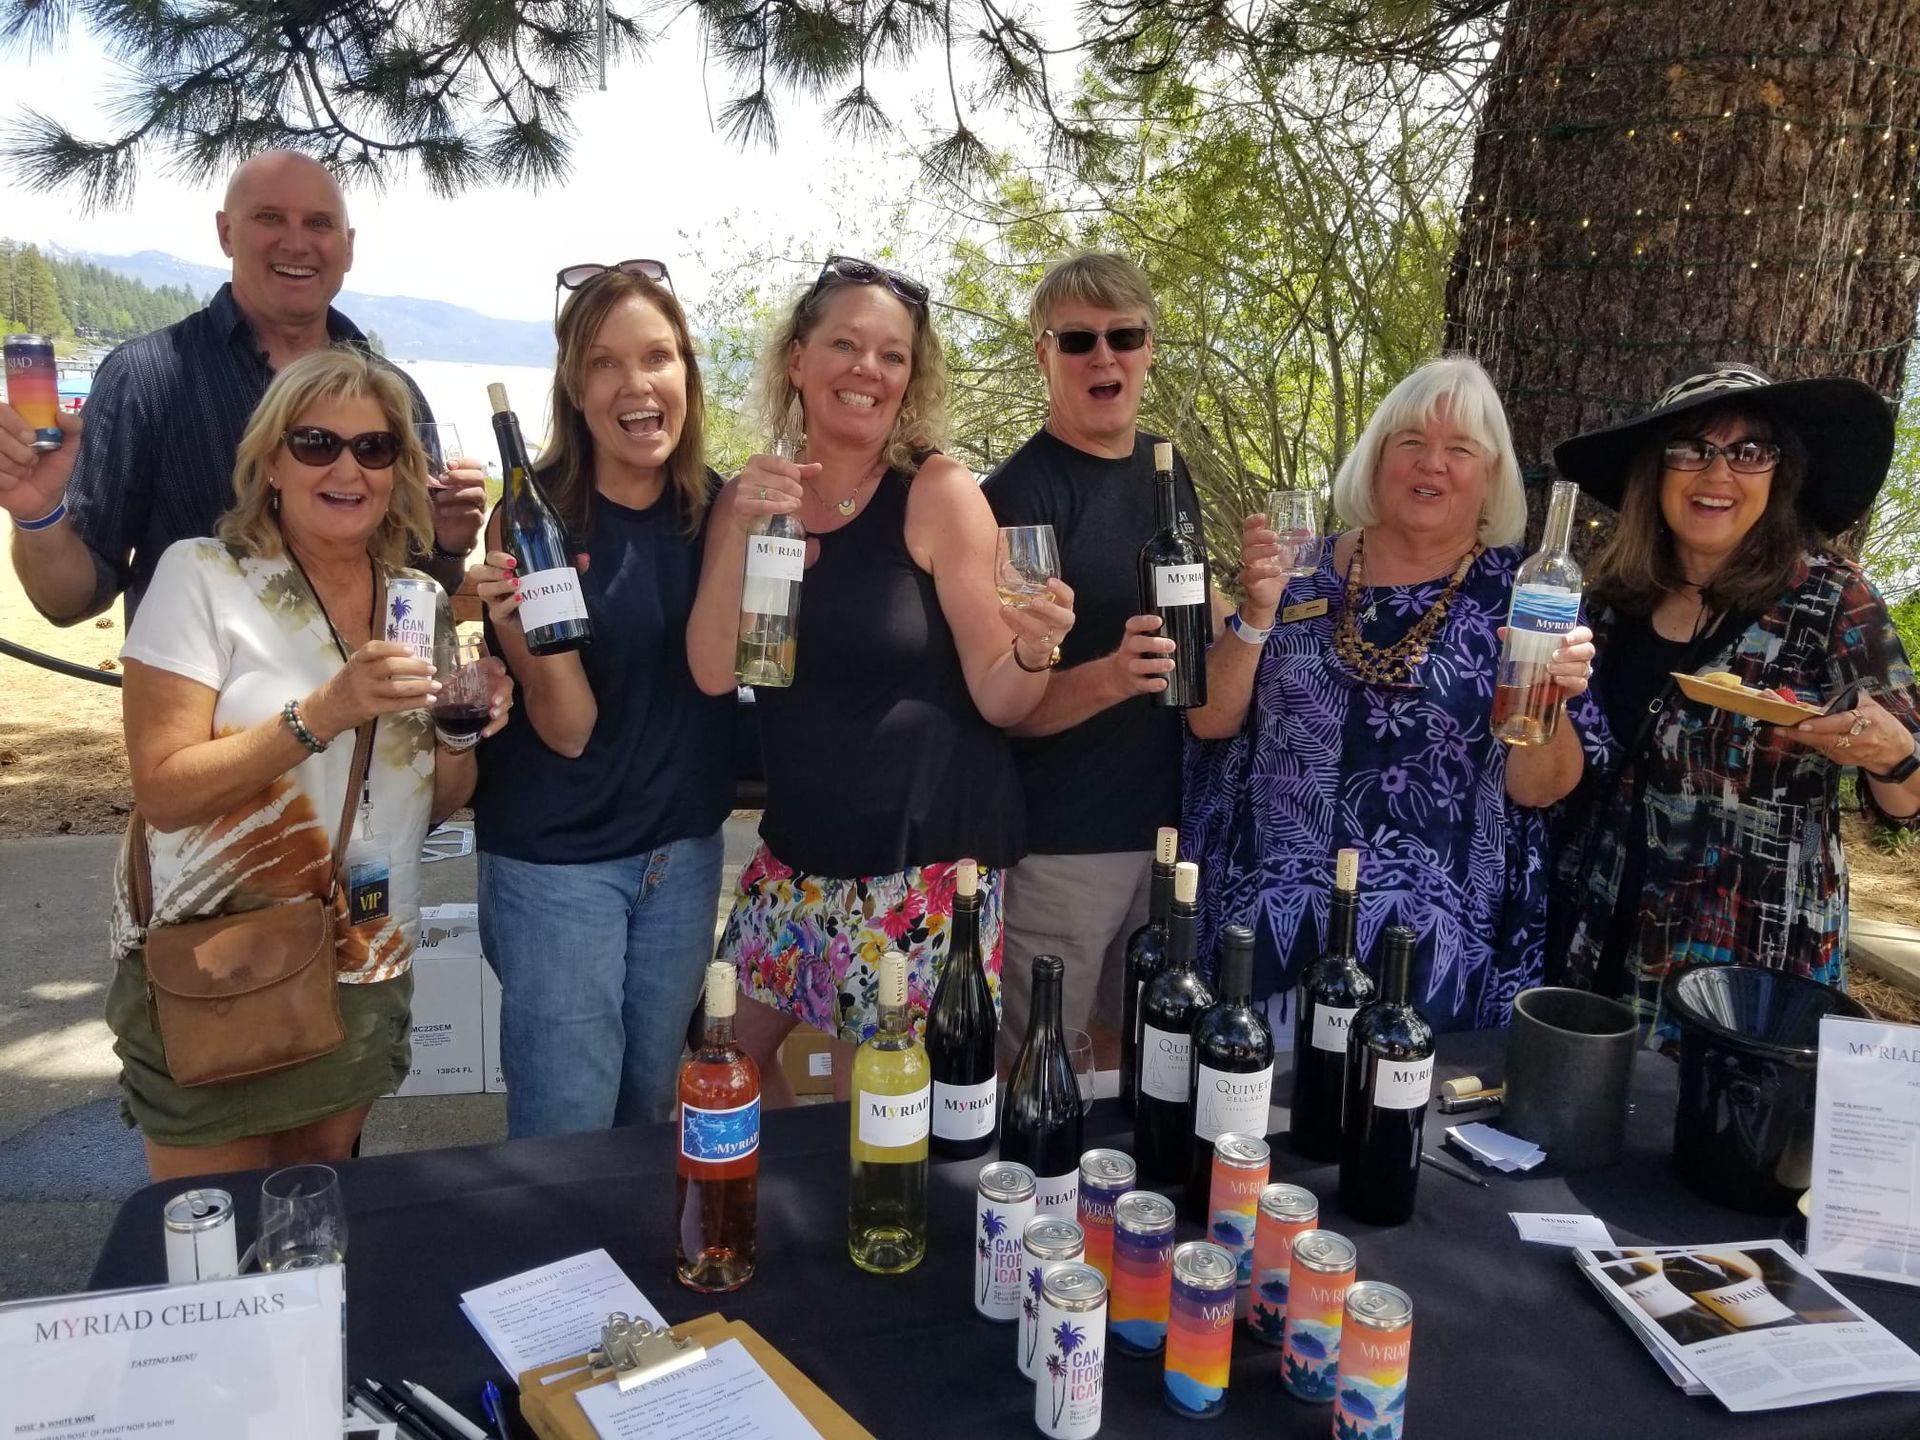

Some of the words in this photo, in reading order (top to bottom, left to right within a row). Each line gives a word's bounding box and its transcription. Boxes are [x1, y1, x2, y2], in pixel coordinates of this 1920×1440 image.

[1168, 572, 1205, 585] MyRIA
[402, 618, 425, 631] CAN
[401, 631, 431, 645] IFORN
[360, 891, 383, 911] VIP
[995, 1238, 1021, 1253] CAN
[34, 1309, 153, 1343] MYRIAD
[161, 1292, 286, 1327] CELLARS
[1072, 1347, 1099, 1367] CAN
[75, 1414, 96, 1424] WINE
